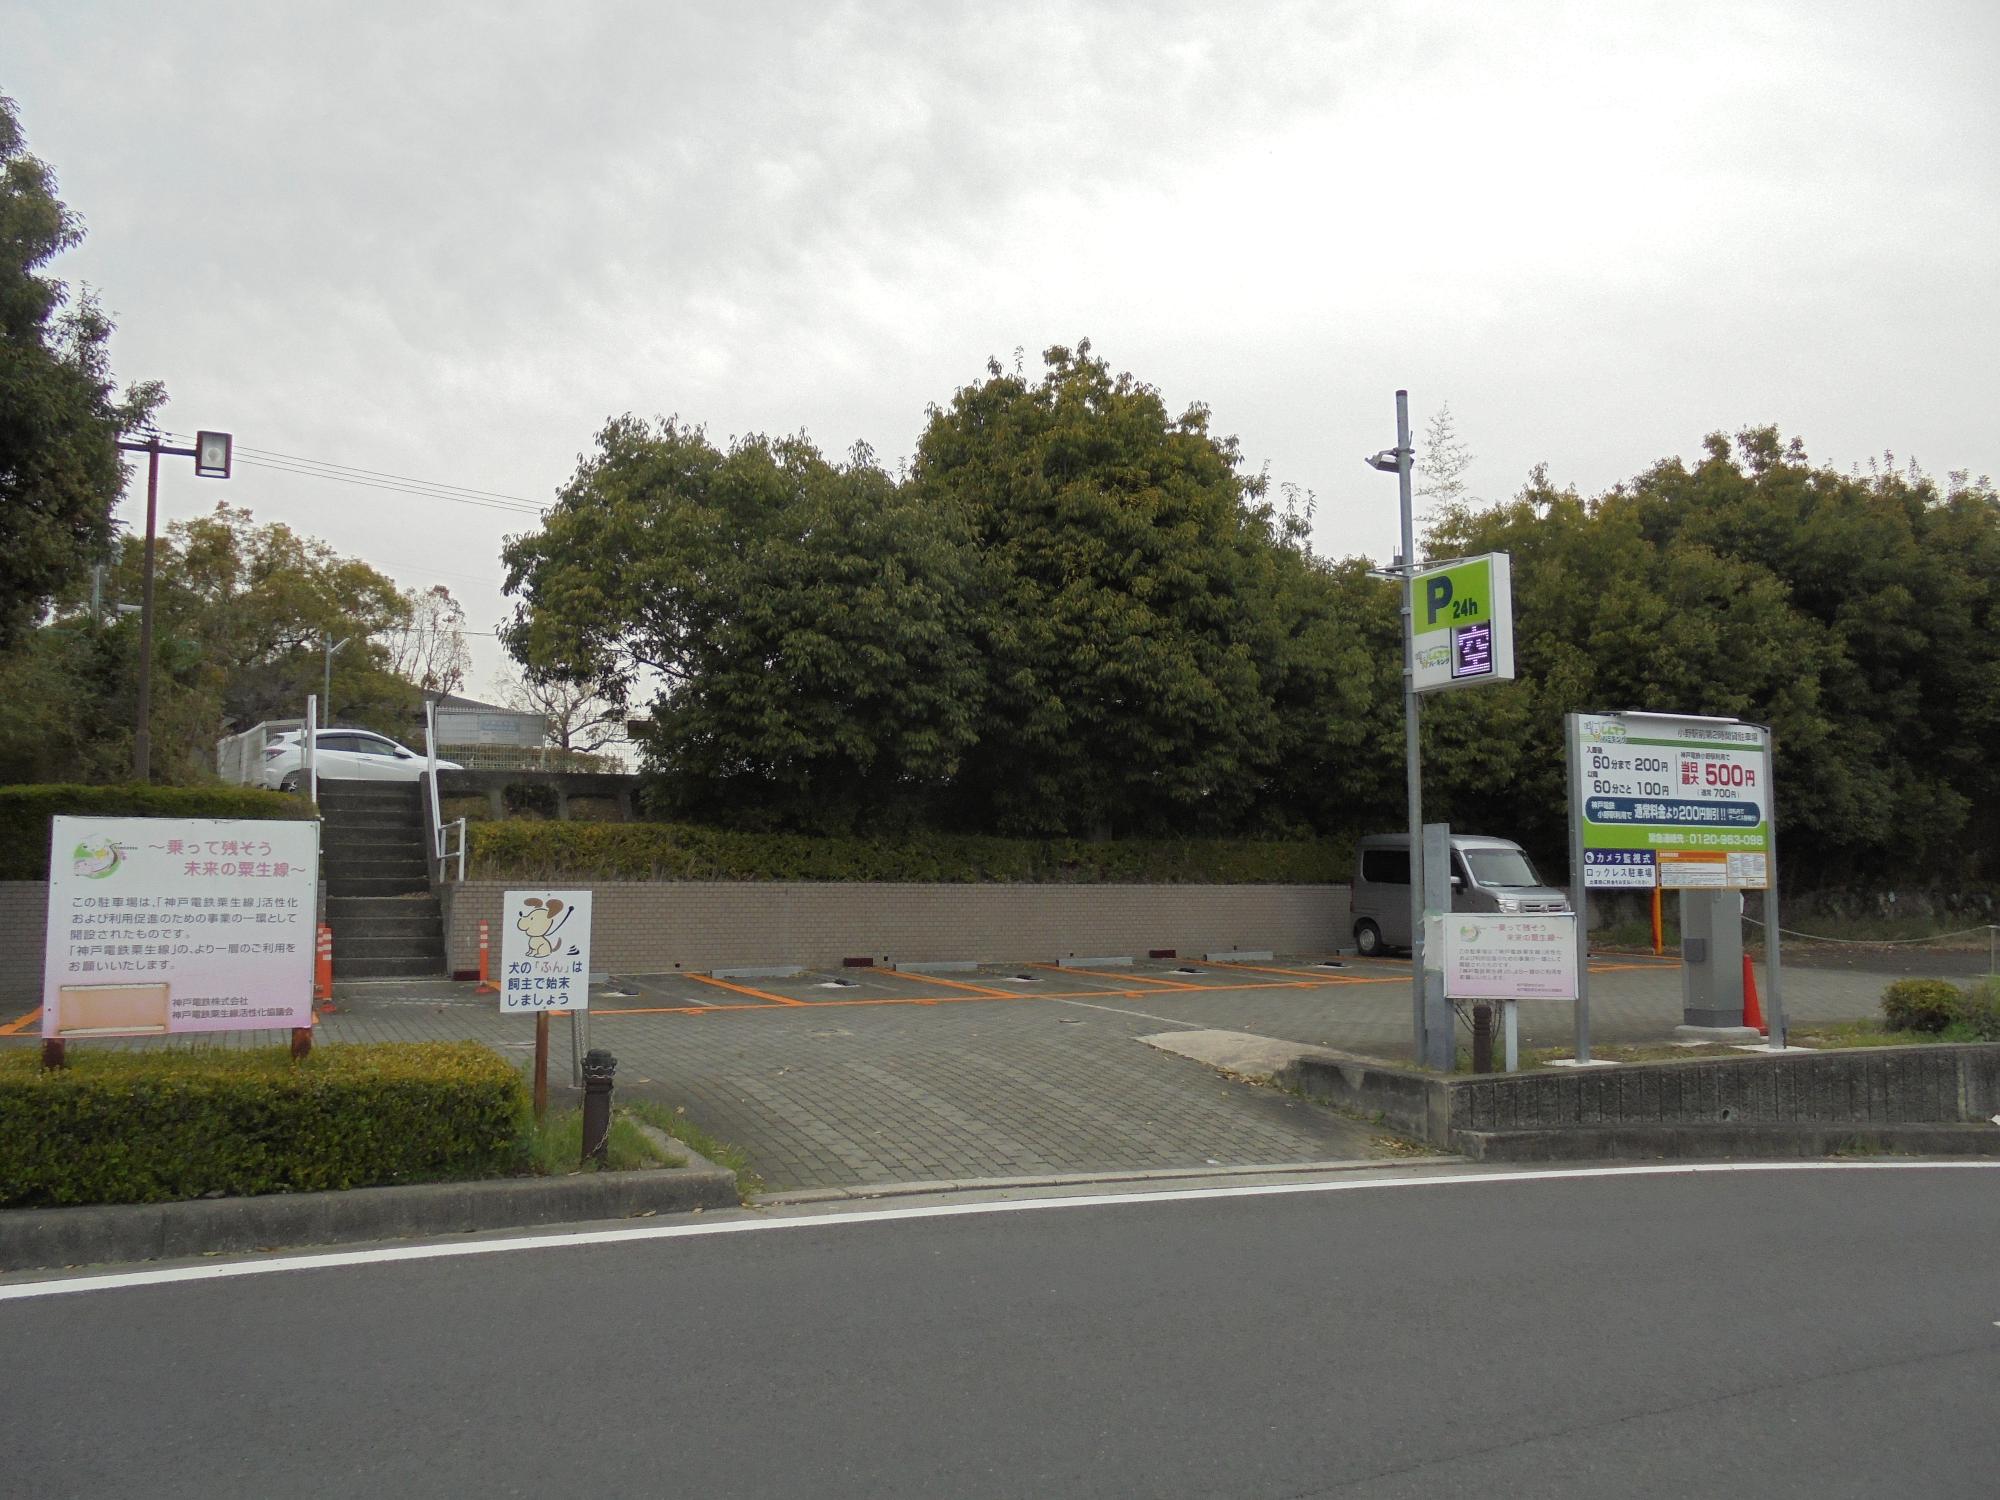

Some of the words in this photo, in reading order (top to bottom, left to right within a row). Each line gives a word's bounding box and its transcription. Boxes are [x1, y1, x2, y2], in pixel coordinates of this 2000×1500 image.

[1427, 575, 1453, 625] P
[1453, 597, 1478, 619] 24h
[1593, 755, 1632, 770] 60分まで
[1635, 758, 1669, 772] 200円
[1681, 761, 1698, 774] 当日
[1681, 773, 1699, 785] 最大
[1706, 764, 1756, 787] 500円
[1593, 780, 1632, 794] 60分ごと
[1637, 781, 1669, 796] 100円
[1586, 866, 1653, 878] ロックレス駐車場
[68, 960, 175, 972] お願いいたします。
[508, 960, 582, 974] 犬の「ふん」は
[508, 977, 571, 990] 飼主で始末
[508, 992, 569, 1006] しましょう
